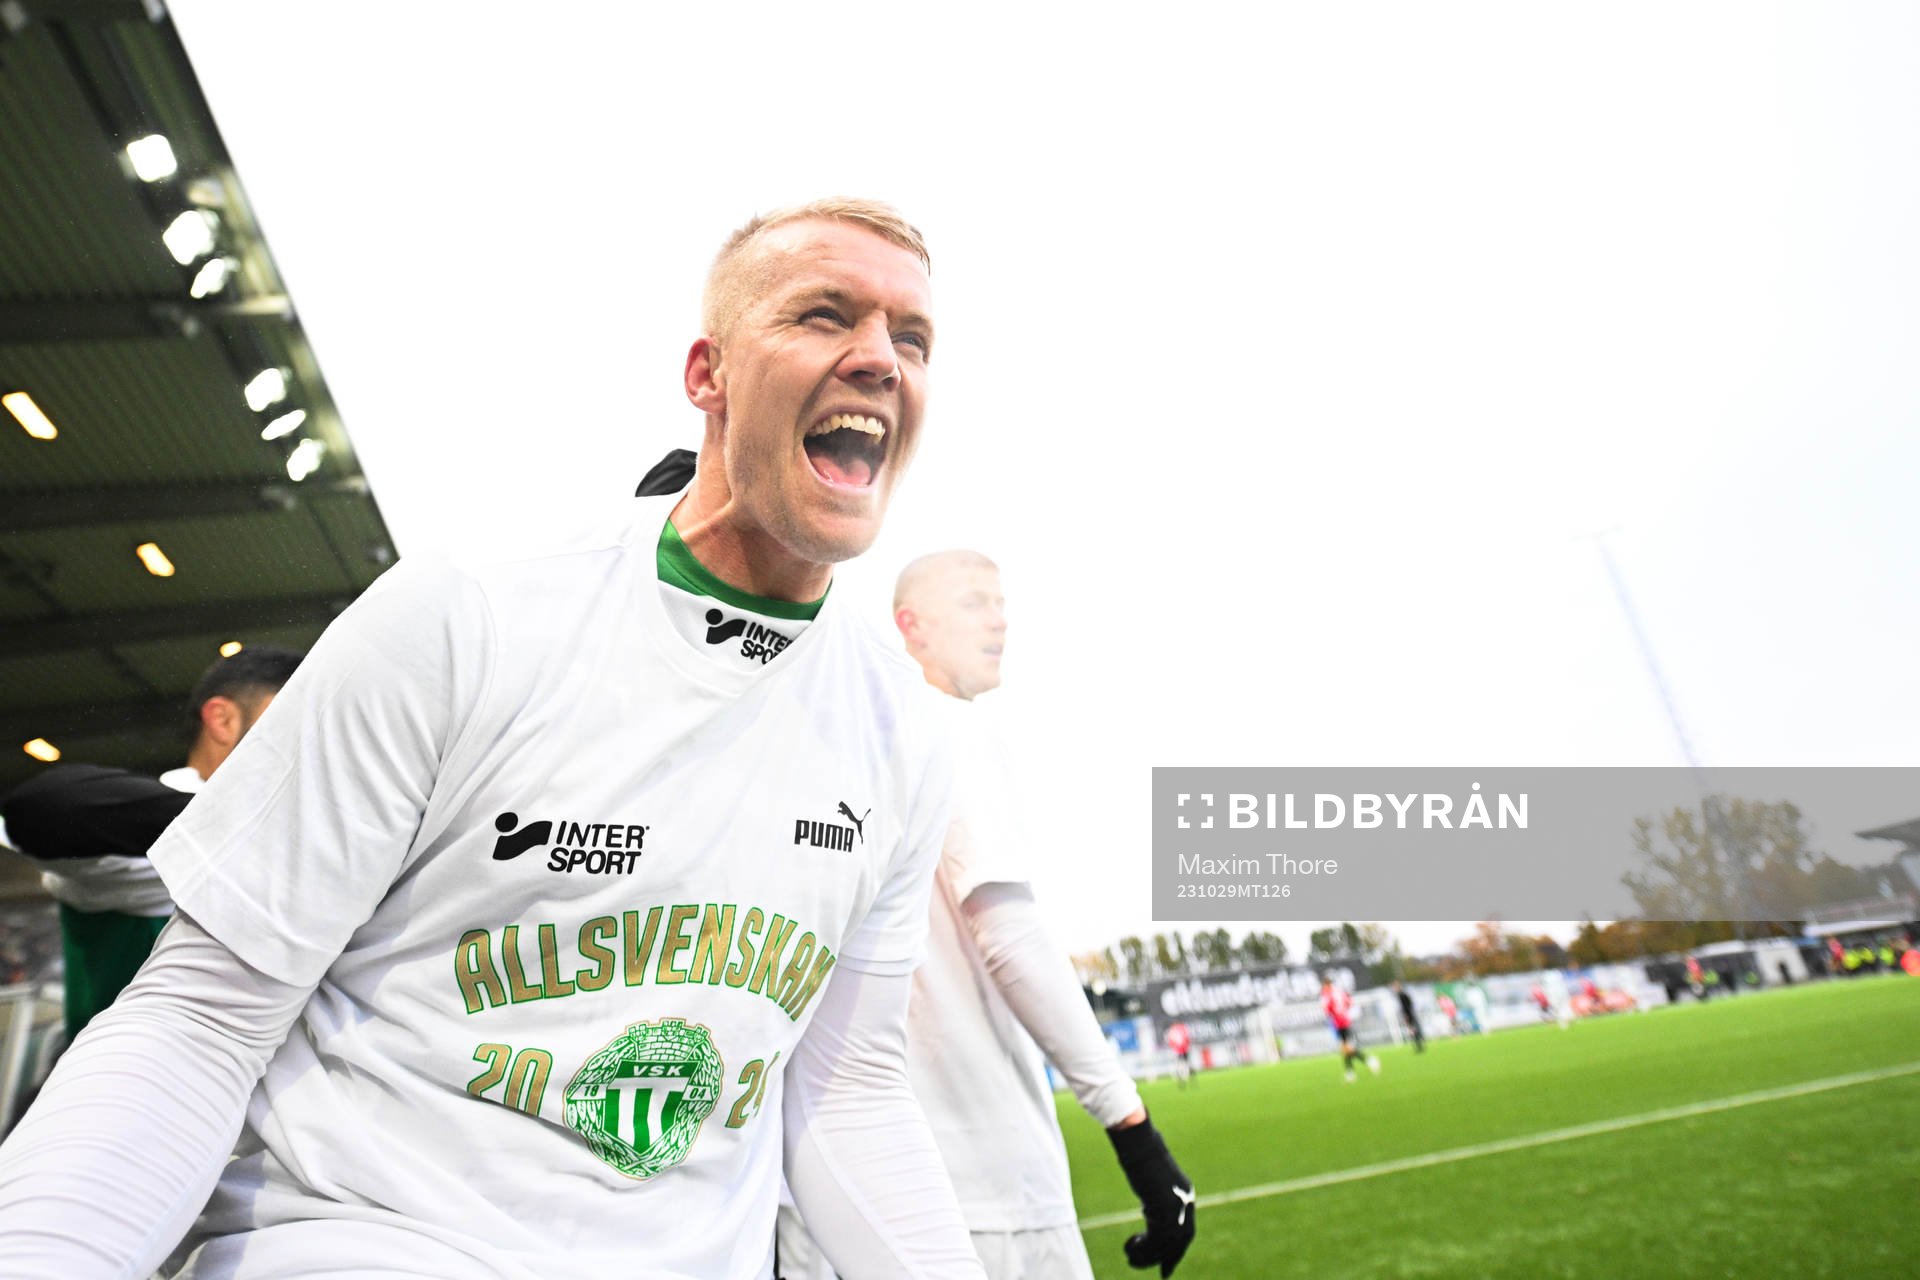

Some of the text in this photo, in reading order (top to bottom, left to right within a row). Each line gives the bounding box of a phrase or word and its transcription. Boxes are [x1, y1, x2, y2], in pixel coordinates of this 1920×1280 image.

[556, 820, 645, 849] INTER
[794, 819, 855, 853] PUMA
[547, 847, 642, 874] SPORT
[454, 903, 836, 1022] ALLSVENSKAN
[466, 1043, 553, 1118] 20
[632, 1064, 685, 1077] VSK
[689, 1087, 707, 1100] 04
